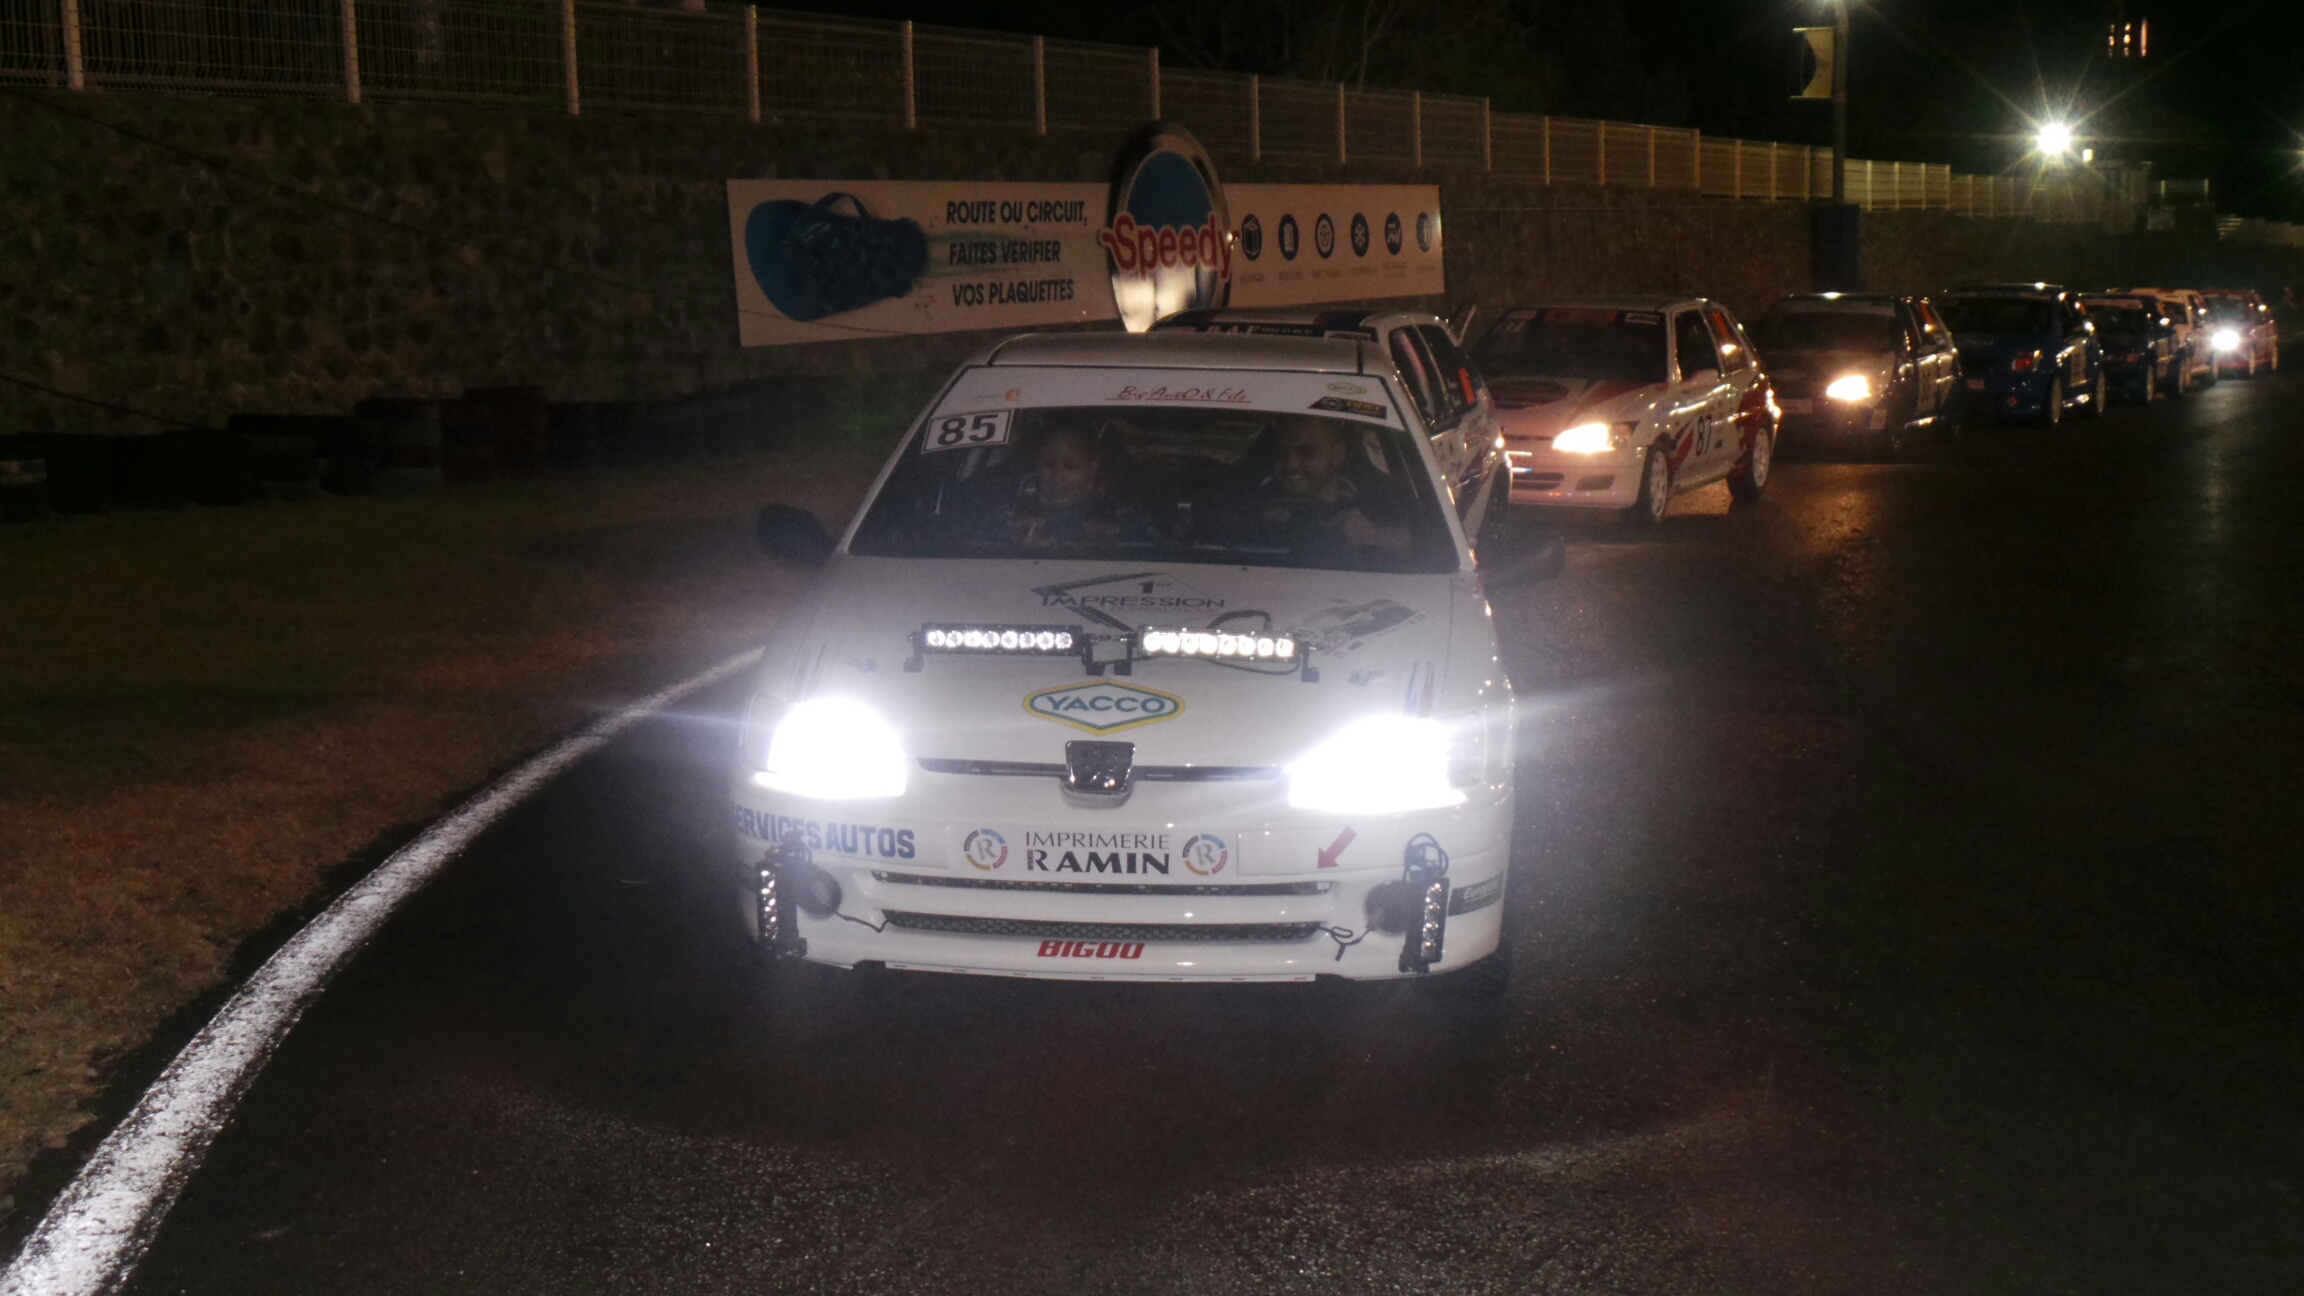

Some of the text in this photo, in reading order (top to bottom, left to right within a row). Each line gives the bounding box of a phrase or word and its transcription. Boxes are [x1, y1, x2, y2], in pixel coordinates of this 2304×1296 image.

[947, 201, 1087, 226] ROUTE OU CIRCUIT,
[950, 240, 1061, 265] FAITES VERIFIER
[1101, 214, 1240, 279] Speedy
[953, 278, 1074, 306] VOS PLAQUETTES
[937, 414, 999, 446] 85
[1695, 414, 1713, 457] 87
[1041, 596, 1226, 608] IMPRESSION
[1046, 695, 1166, 714] YACCO
[826, 822, 916, 860] AUTOS
[1026, 831, 1170, 850] IMPRIMERIE
[1026, 849, 1170, 875] RAMIN
